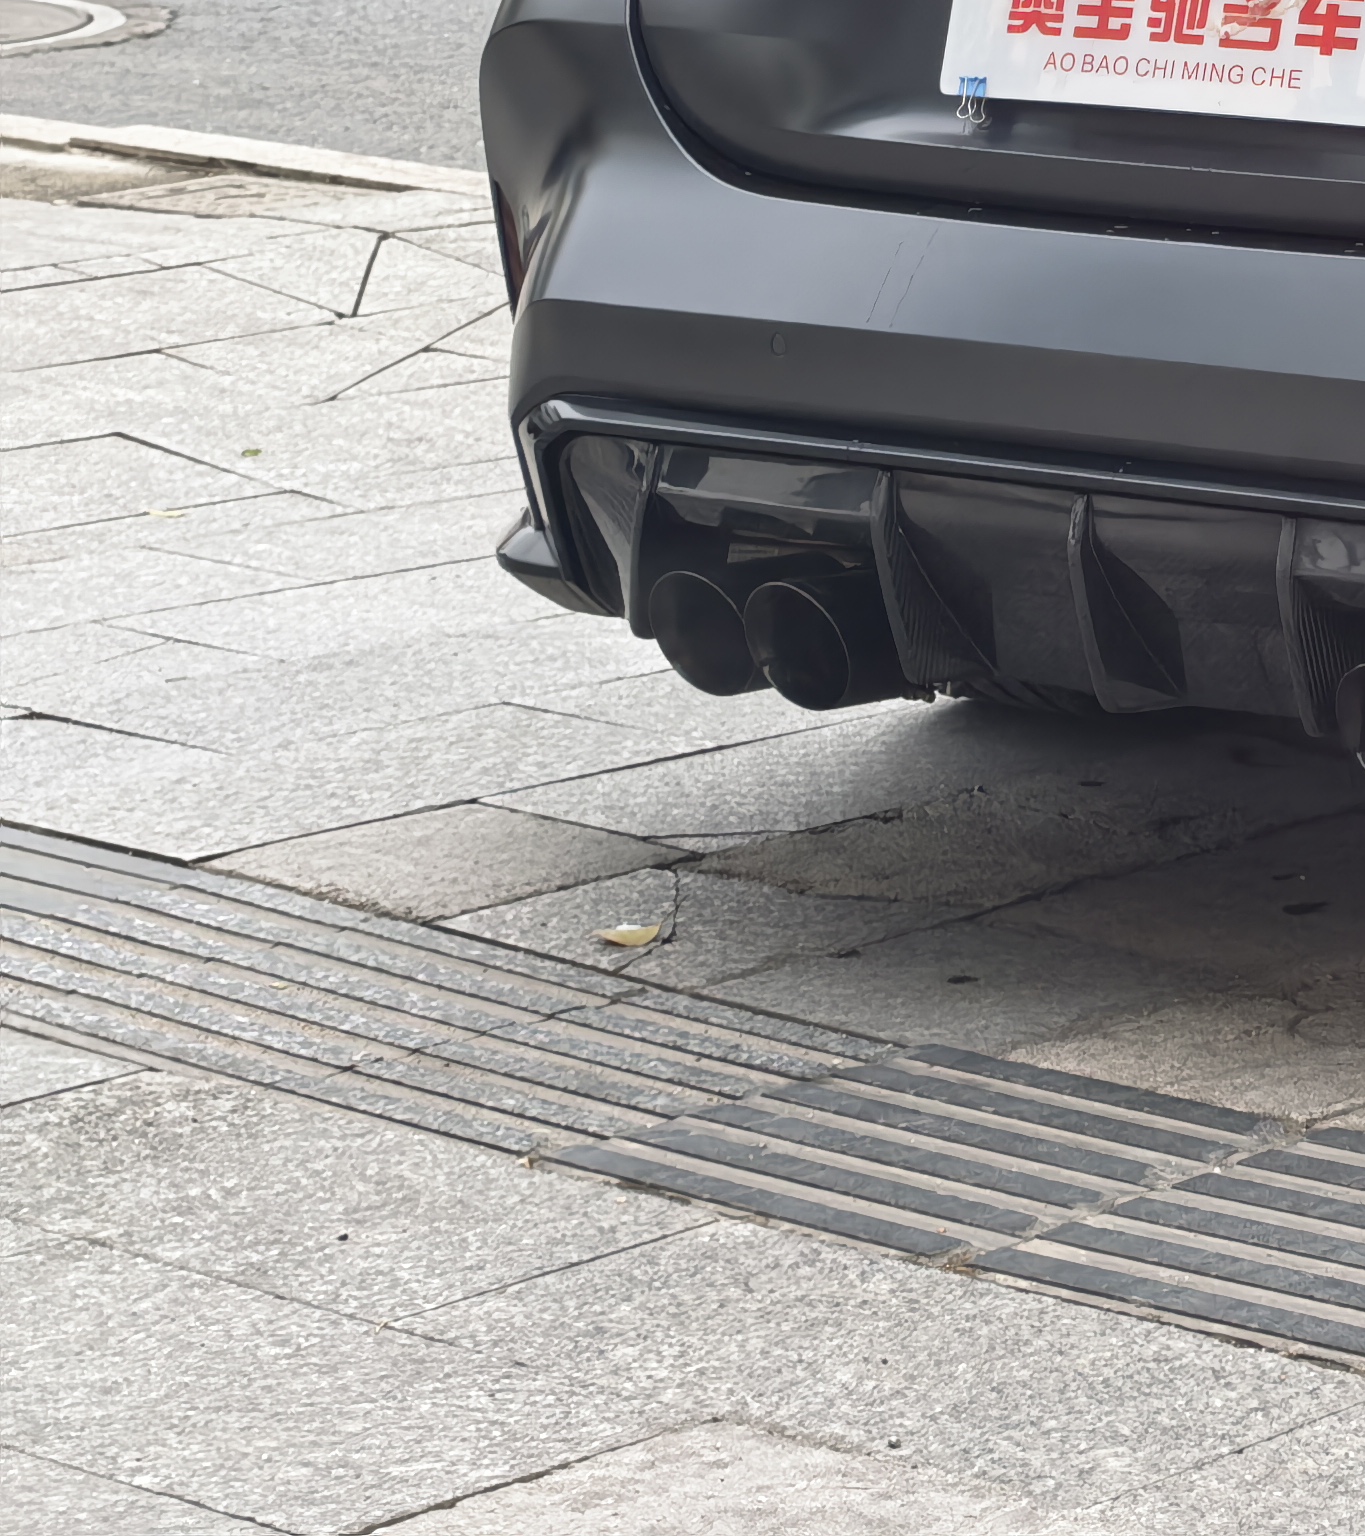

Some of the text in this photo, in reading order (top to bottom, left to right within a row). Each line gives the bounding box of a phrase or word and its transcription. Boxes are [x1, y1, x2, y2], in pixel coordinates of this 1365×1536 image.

[1043, 51, 1304, 91] AO BAO CHI MING CHE
